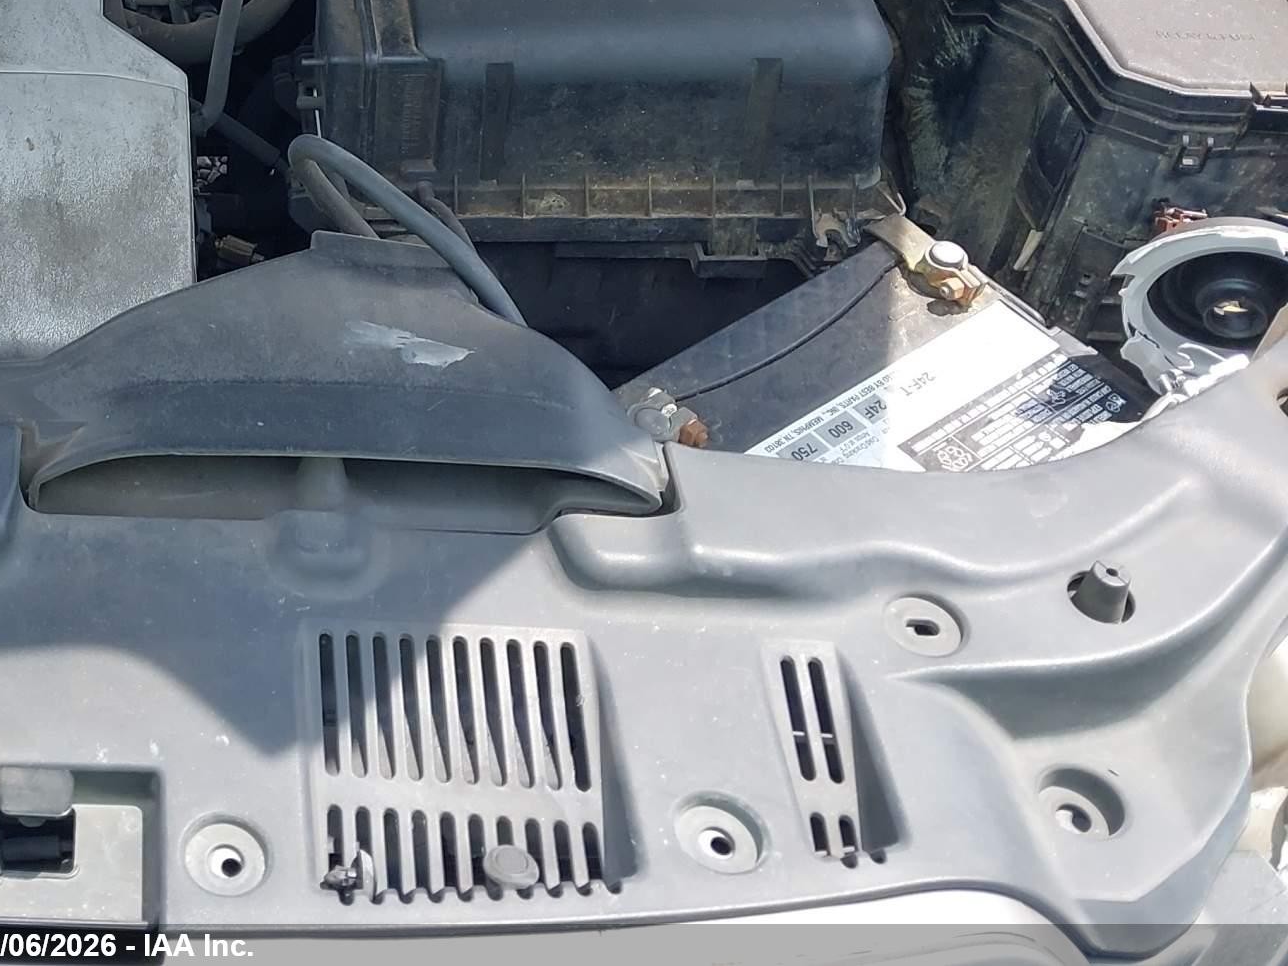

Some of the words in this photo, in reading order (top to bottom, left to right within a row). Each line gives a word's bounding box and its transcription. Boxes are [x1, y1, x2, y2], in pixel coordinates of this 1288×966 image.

[862, 399, 887, 419] 24F
[827, 419, 853, 439] 600
[790, 442, 817, 462] 750
